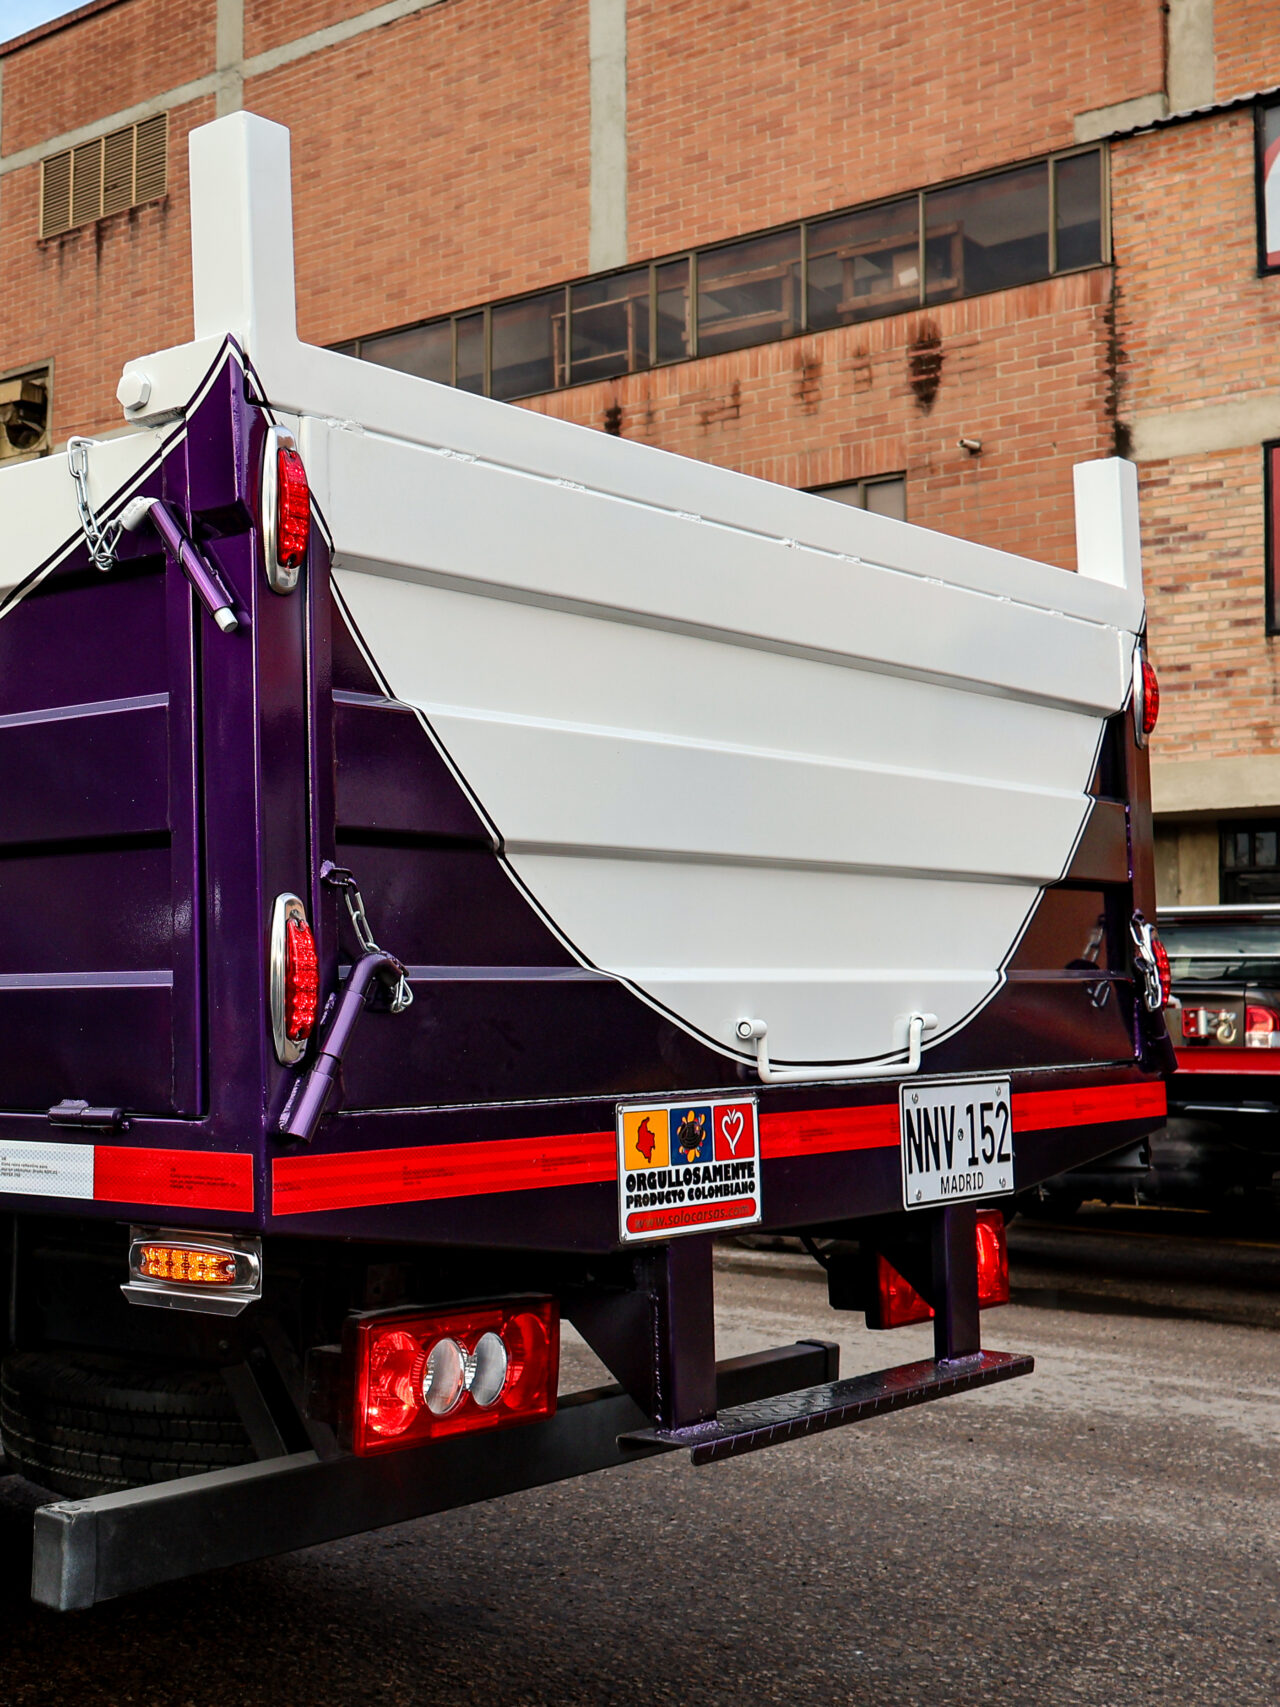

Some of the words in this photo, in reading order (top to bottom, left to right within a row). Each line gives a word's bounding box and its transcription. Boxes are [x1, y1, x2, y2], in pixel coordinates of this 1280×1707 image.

[906, 1105, 955, 1175] NNV
[966, 1101, 1011, 1167] 152
[626, 1161, 755, 1193] ORGULLOSAMENTE
[940, 1171, 984, 1195] MADRID
[626, 1189, 686, 1209] PRODUCTO
[687, 1180, 756, 1201] COLOMBIANO
[634, 1204, 750, 1229] www.solocarsas.com
